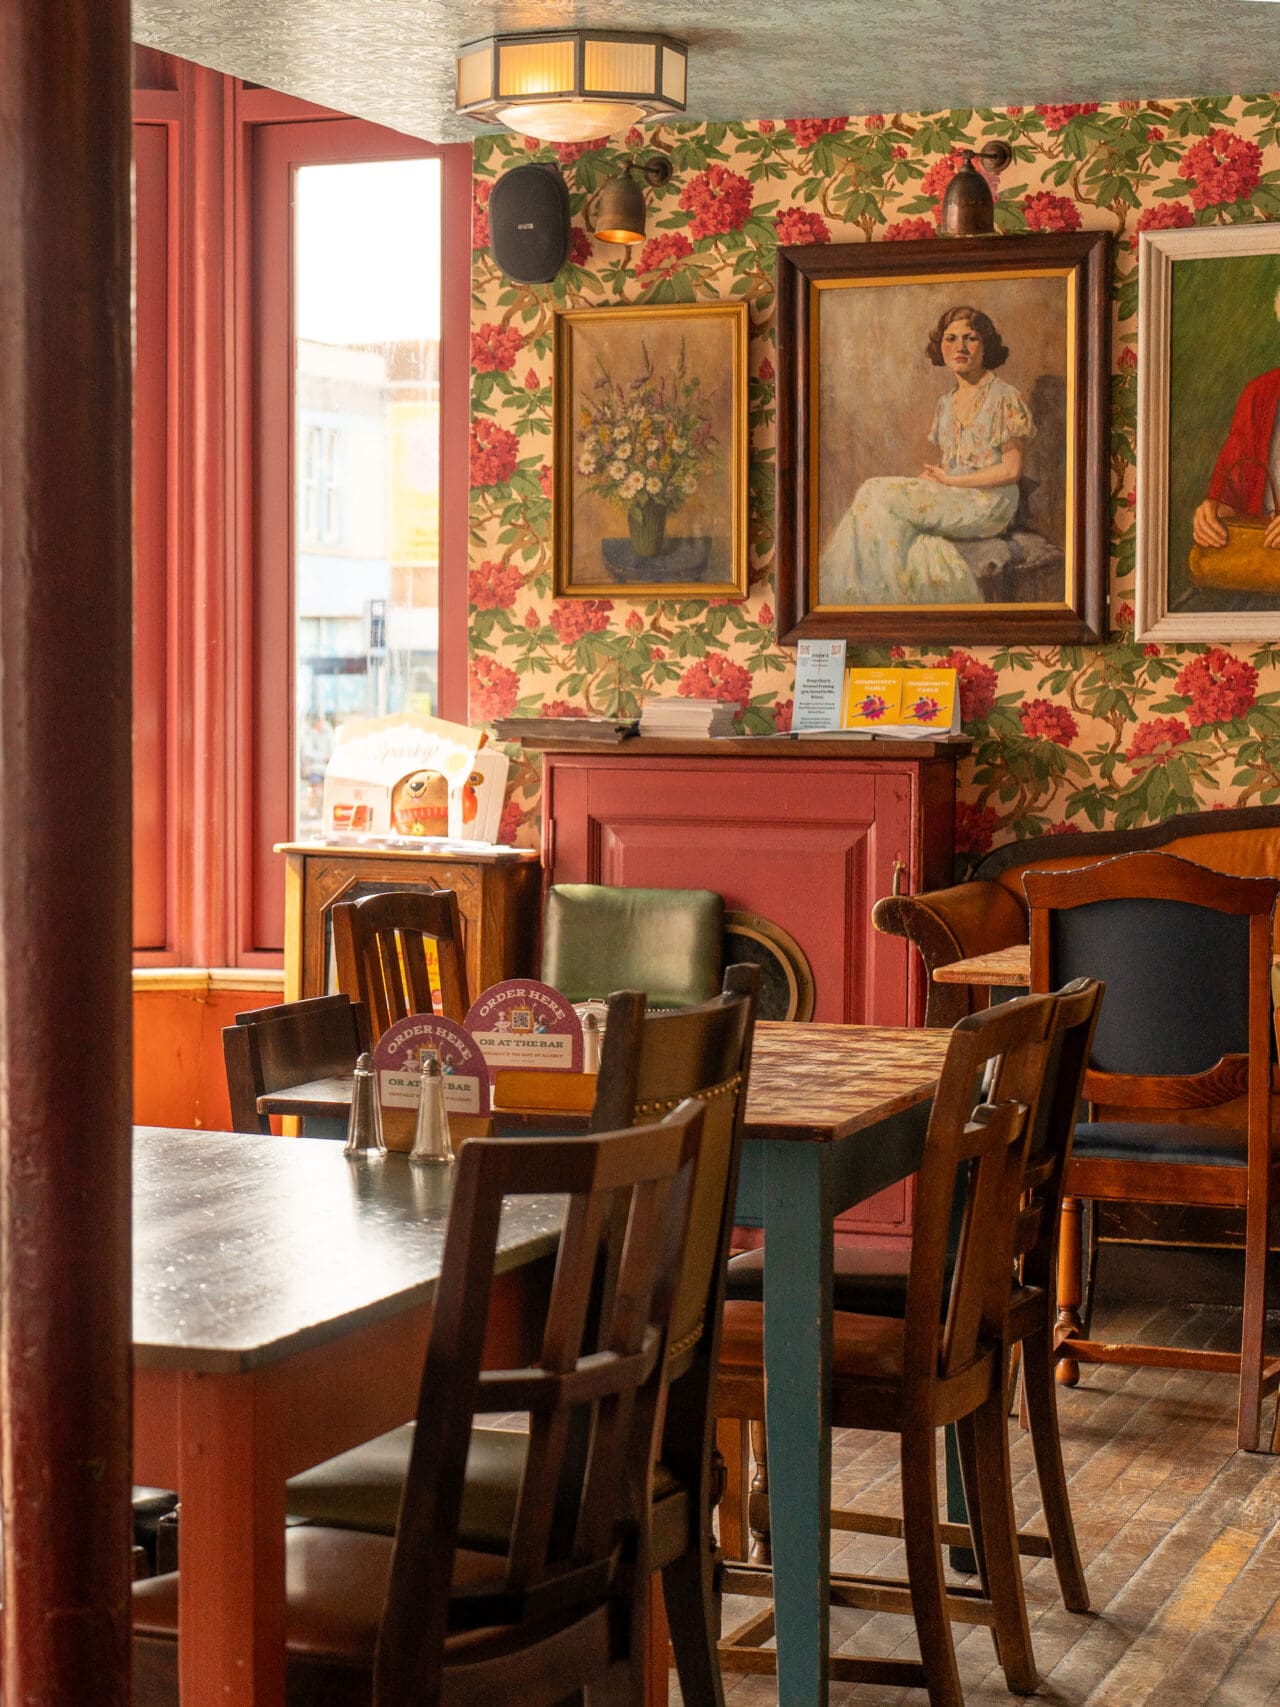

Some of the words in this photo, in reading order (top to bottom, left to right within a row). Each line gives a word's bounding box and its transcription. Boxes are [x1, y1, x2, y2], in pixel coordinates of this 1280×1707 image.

[479, 988, 526, 1017] ORDER
[528, 990, 567, 1020] HERE
[387, 1024, 433, 1055] ORDER
[435, 1026, 473, 1060] HERE
[479, 1038, 497, 1046] OR
[497, 1039, 513, 1047] AT
[513, 1040, 539, 1048] THE
[539, 1041, 564, 1049] BAR
[388, 1078, 405, 1086] OR
[406, 1079, 422, 1088] AT
[447, 1083, 472, 1092] BAR
